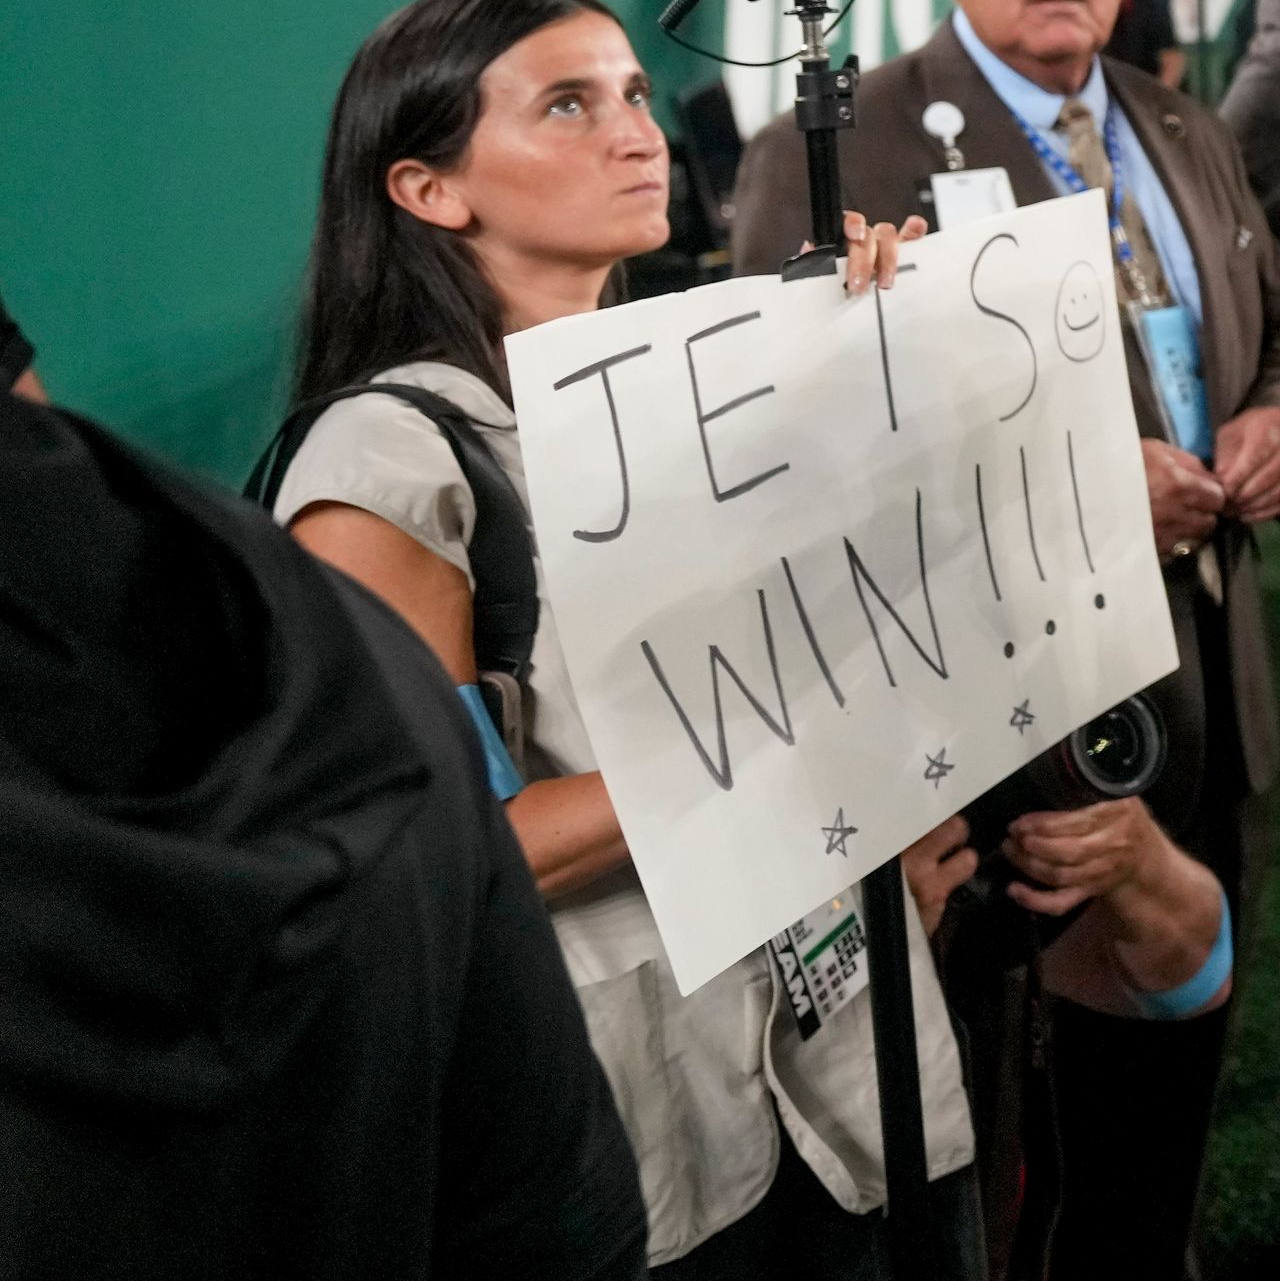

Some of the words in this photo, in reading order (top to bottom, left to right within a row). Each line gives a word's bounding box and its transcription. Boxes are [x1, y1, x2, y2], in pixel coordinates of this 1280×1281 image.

[553, 232, 1038, 543] JETS
[641, 430, 1106, 791] WIN!!!
[770, 927, 813, 1019] EAM
